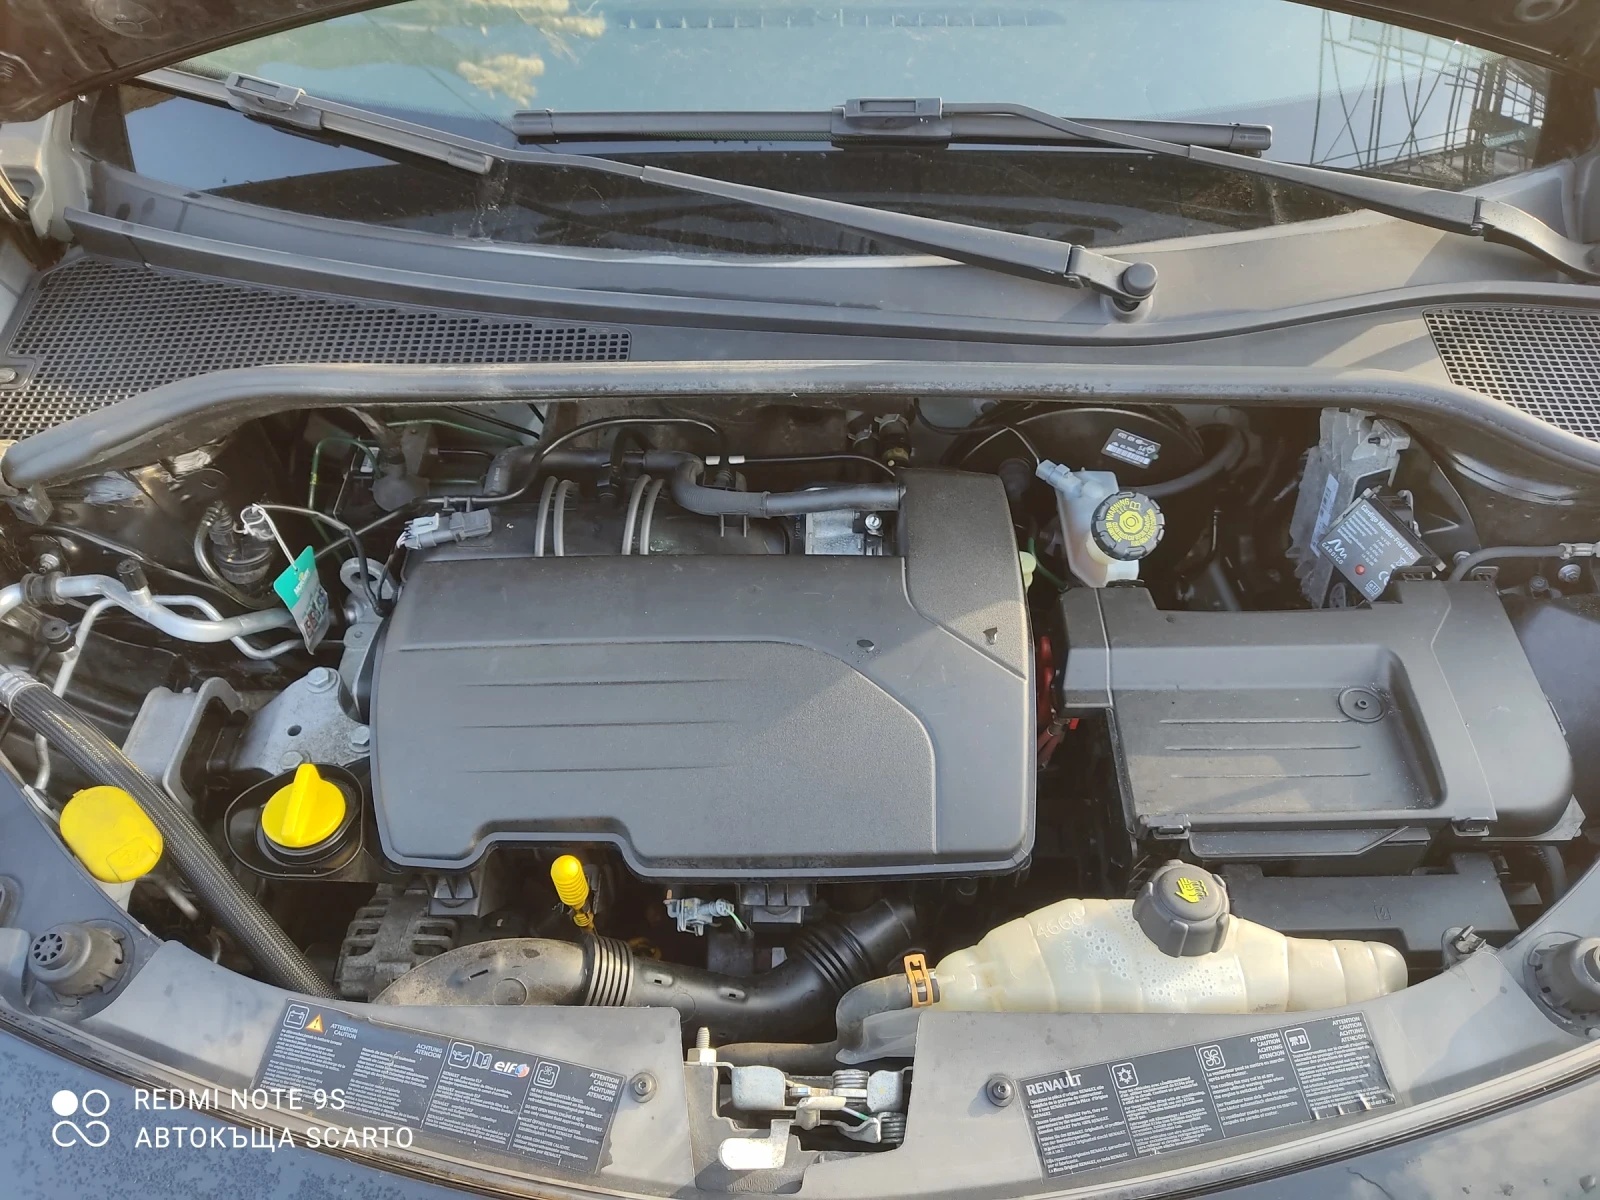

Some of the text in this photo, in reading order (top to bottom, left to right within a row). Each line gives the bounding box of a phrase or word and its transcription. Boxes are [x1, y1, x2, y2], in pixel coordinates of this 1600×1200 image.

[1106, 498, 1130, 520] WARNING
[1358, 503, 1379, 524] Gardigo
[1401, 545, 1416, 560] Auto
[1331, 1015, 1360, 1026] ATTENTION
[1338, 1021, 1362, 1030] CAUTION
[330, 1022, 358, 1034] ATTENTION
[1338, 1027, 1364, 1037] ACHTUNG
[333, 1029, 357, 1039] CAUTION
[1249, 1032, 1279, 1042] ATTENTION
[1256, 1037, 1280, 1047] CAUTION
[416, 1042, 443, 1054] ACHTUNG
[1256, 1043, 1283, 1053] ACHTUNG
[493, 1059, 517, 1074] elf
[589, 1072, 619, 1083] ATTENTION
[592, 1079, 617, 1089] CAUTION
[1025, 1073, 1083, 1096] RENAULT
[588, 1084, 616, 1096] ACHTUNG
